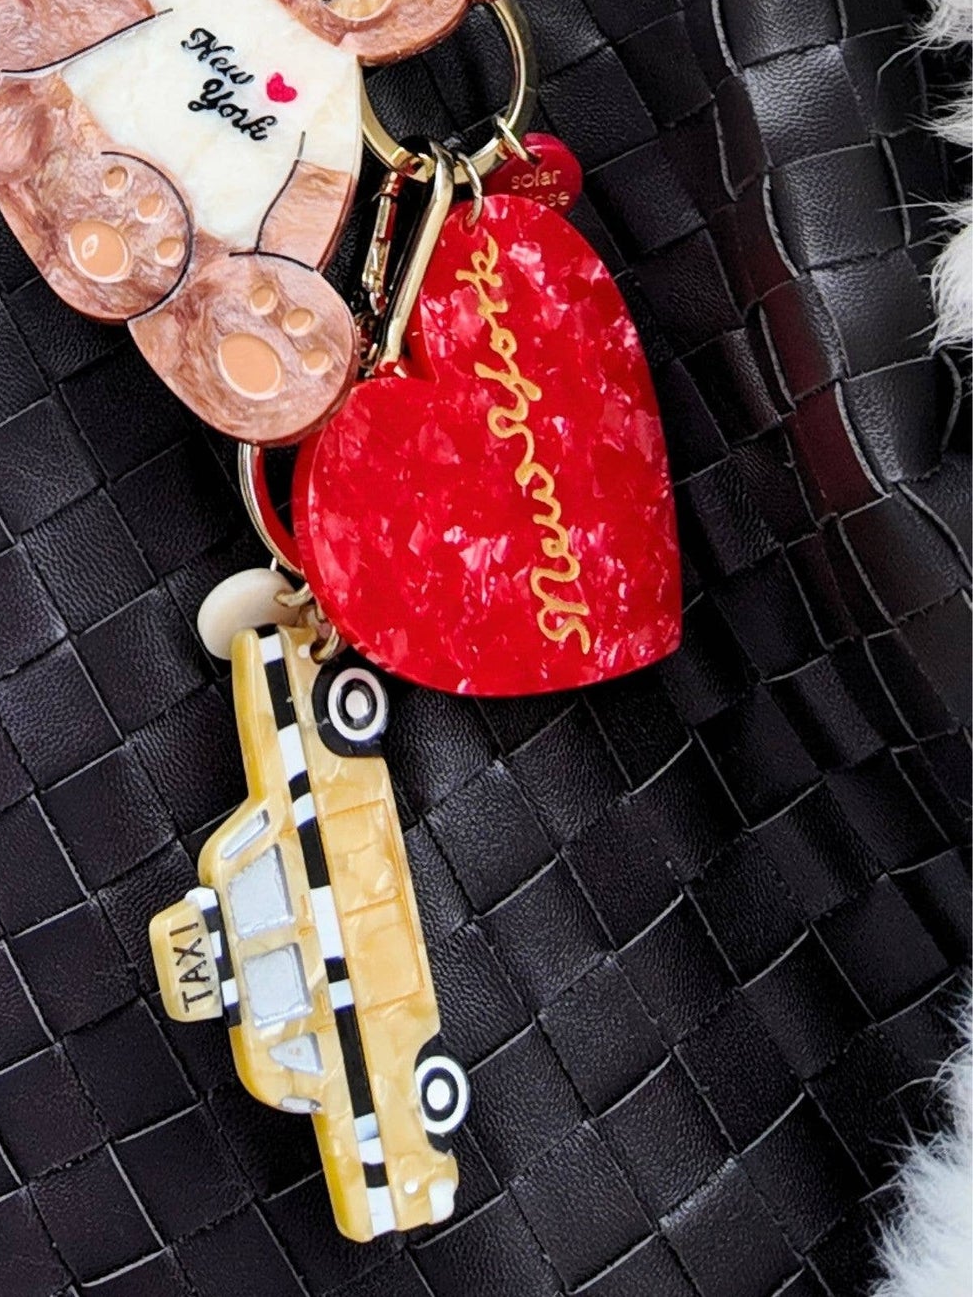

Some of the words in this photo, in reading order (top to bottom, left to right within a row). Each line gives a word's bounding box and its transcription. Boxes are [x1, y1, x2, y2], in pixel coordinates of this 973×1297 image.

[180, 27, 255, 85] New
[187, 78, 277, 141] York
[511, 166, 561, 190] solar
[514, 454, 591, 655] New
[169, 922, 213, 1013] TAXI
